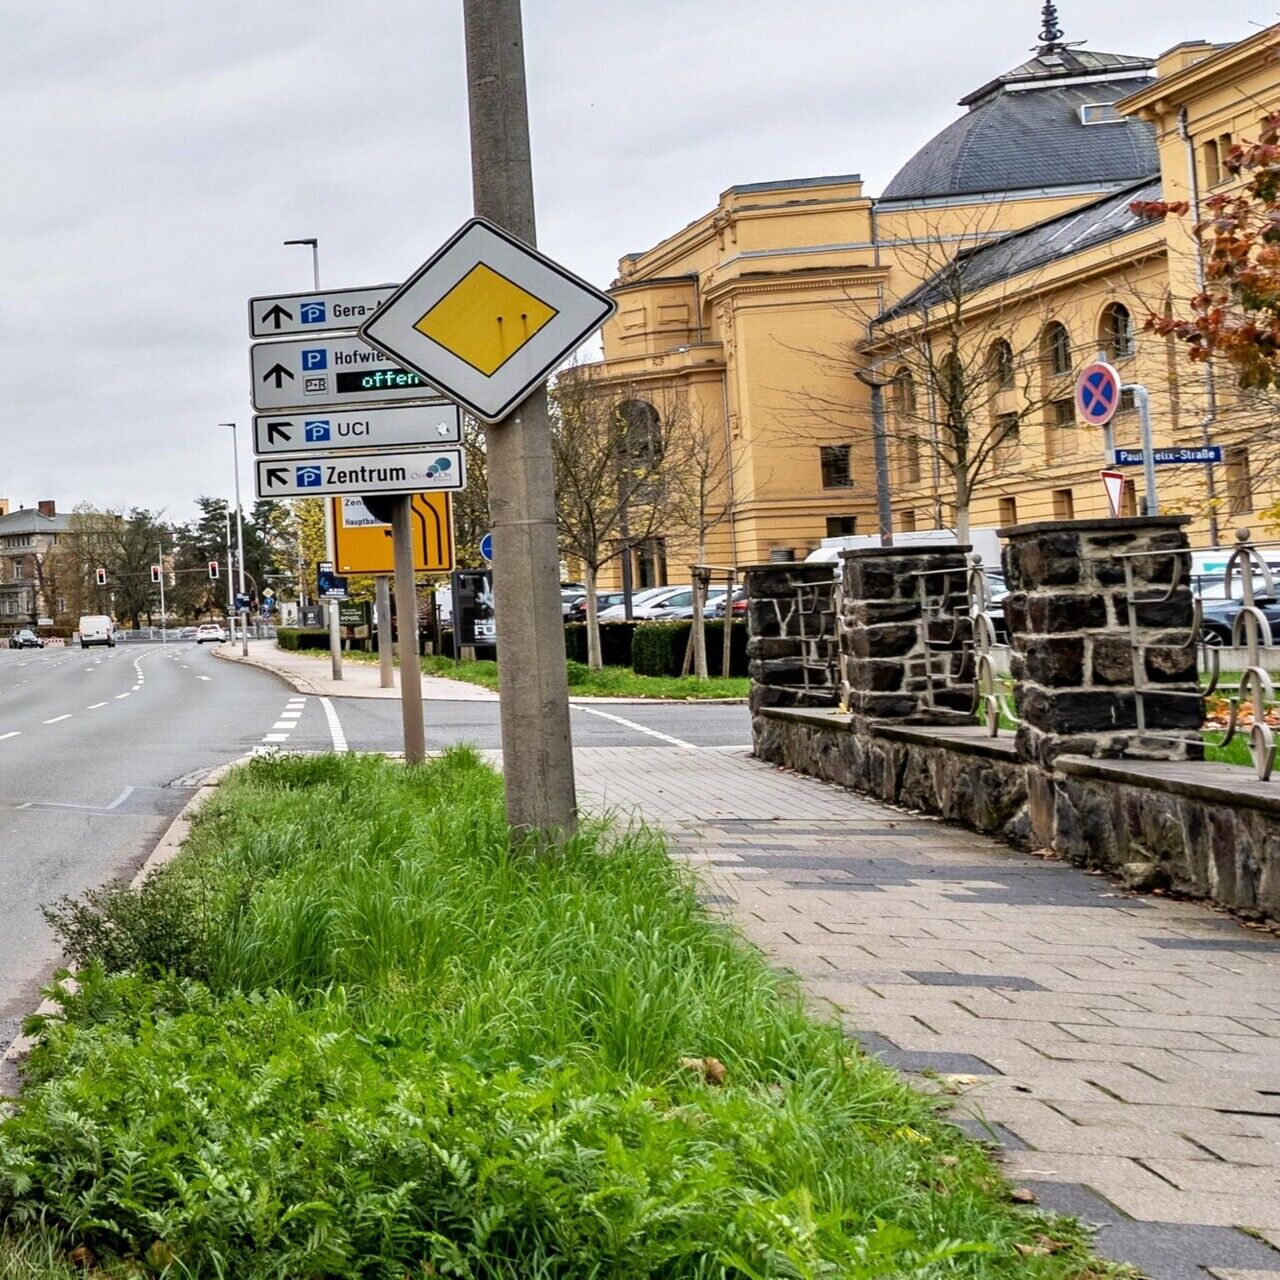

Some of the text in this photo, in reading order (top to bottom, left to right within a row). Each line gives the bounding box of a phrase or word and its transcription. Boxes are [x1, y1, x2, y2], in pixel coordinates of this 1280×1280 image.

[333, 300, 382, 318] Gera-
[334, 348, 390, 365] Hofwie
[362, 371, 419, 387] offen
[337, 421, 370, 437] UCI
[326, 466, 406, 485] Zentrum
[344, 499, 362, 507] Zen
